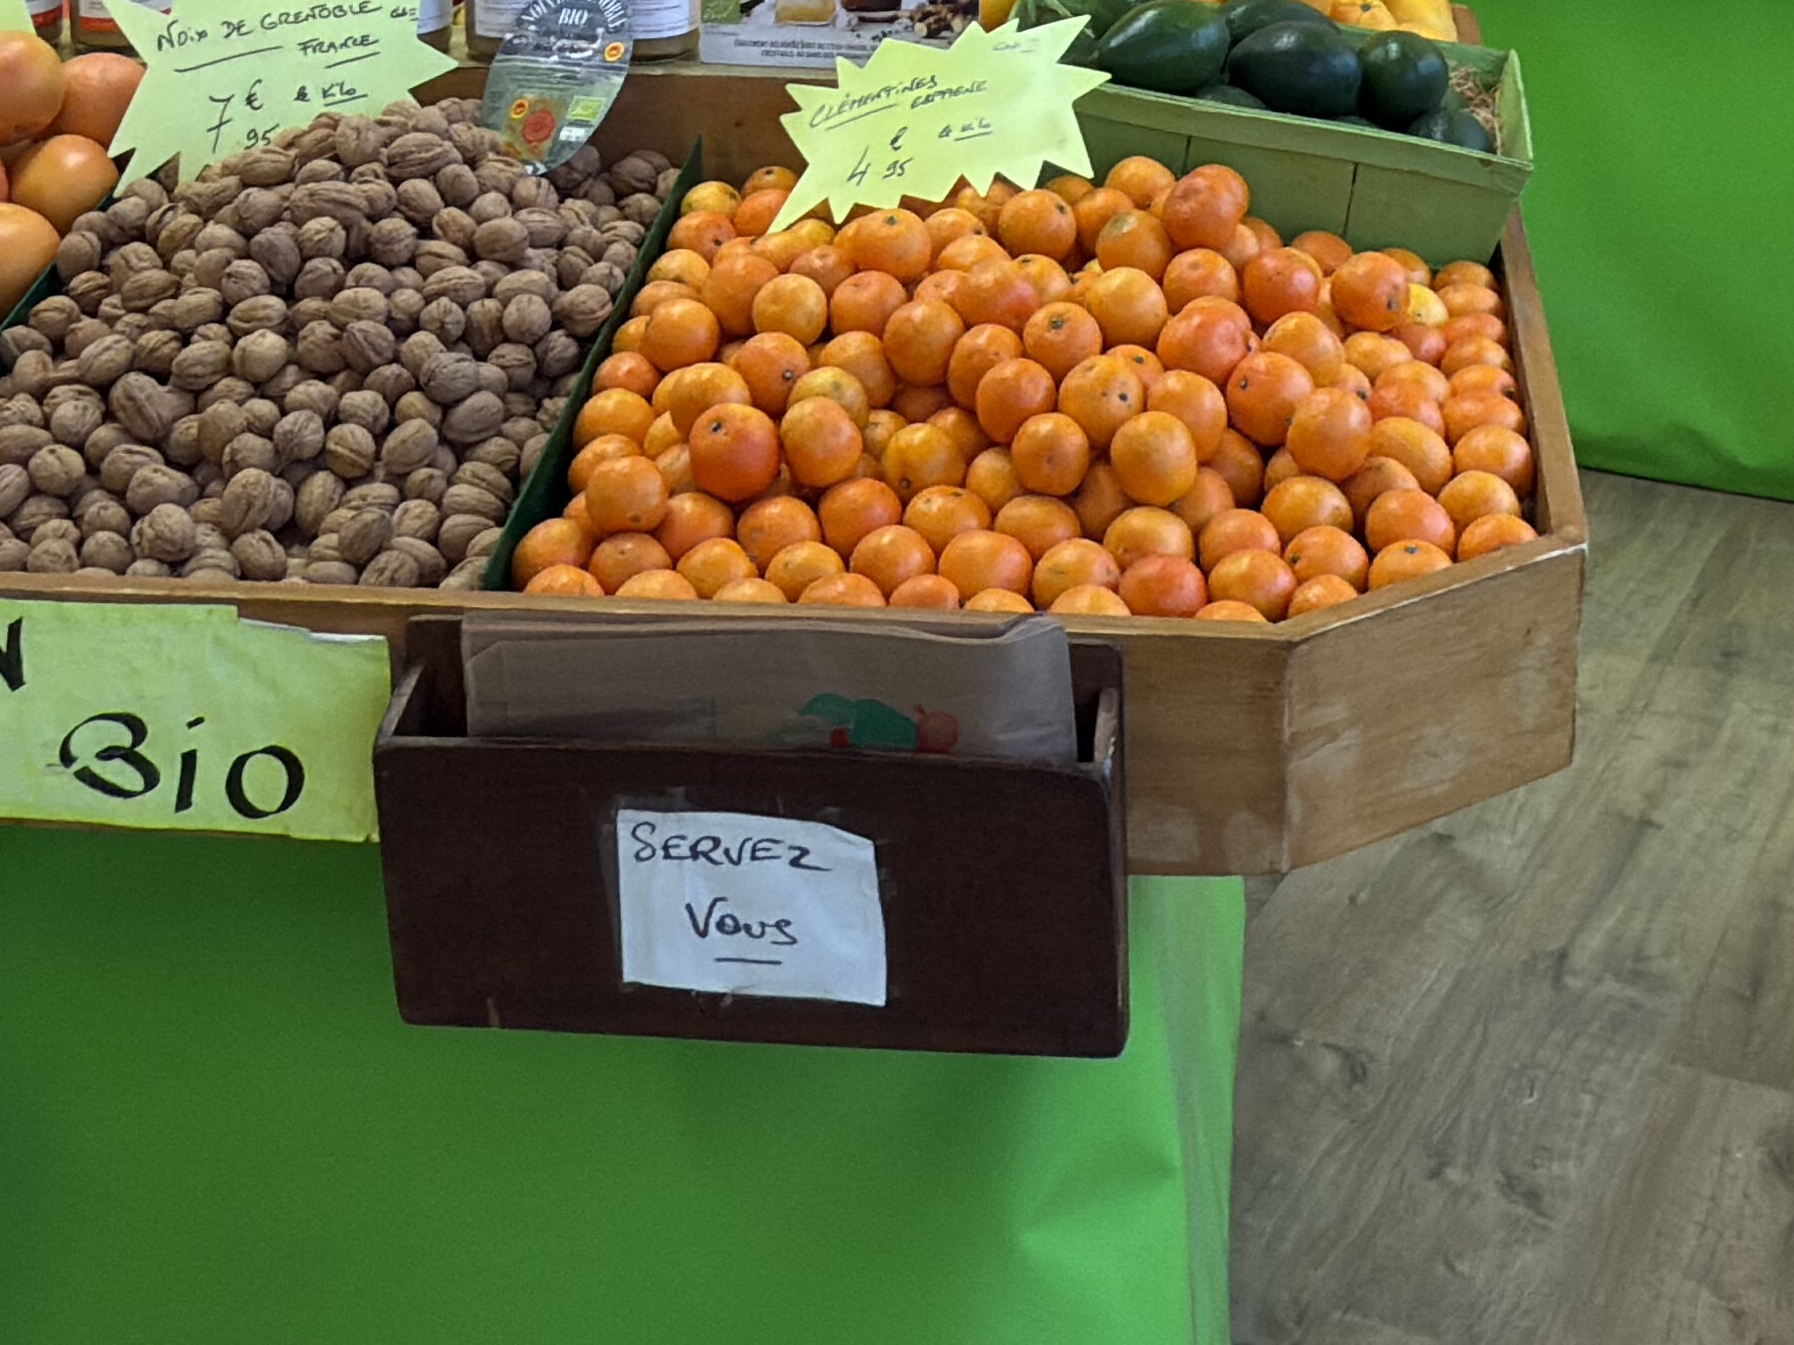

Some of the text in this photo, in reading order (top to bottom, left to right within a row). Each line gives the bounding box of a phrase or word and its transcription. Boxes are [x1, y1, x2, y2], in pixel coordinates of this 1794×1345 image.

[221, 18, 255, 37] DE
[557, 7, 591, 26] BIO
[206, 79, 265, 153] 7 €
[846, 144, 871, 186] 4
[630, 820, 833, 872] SERVEZ
